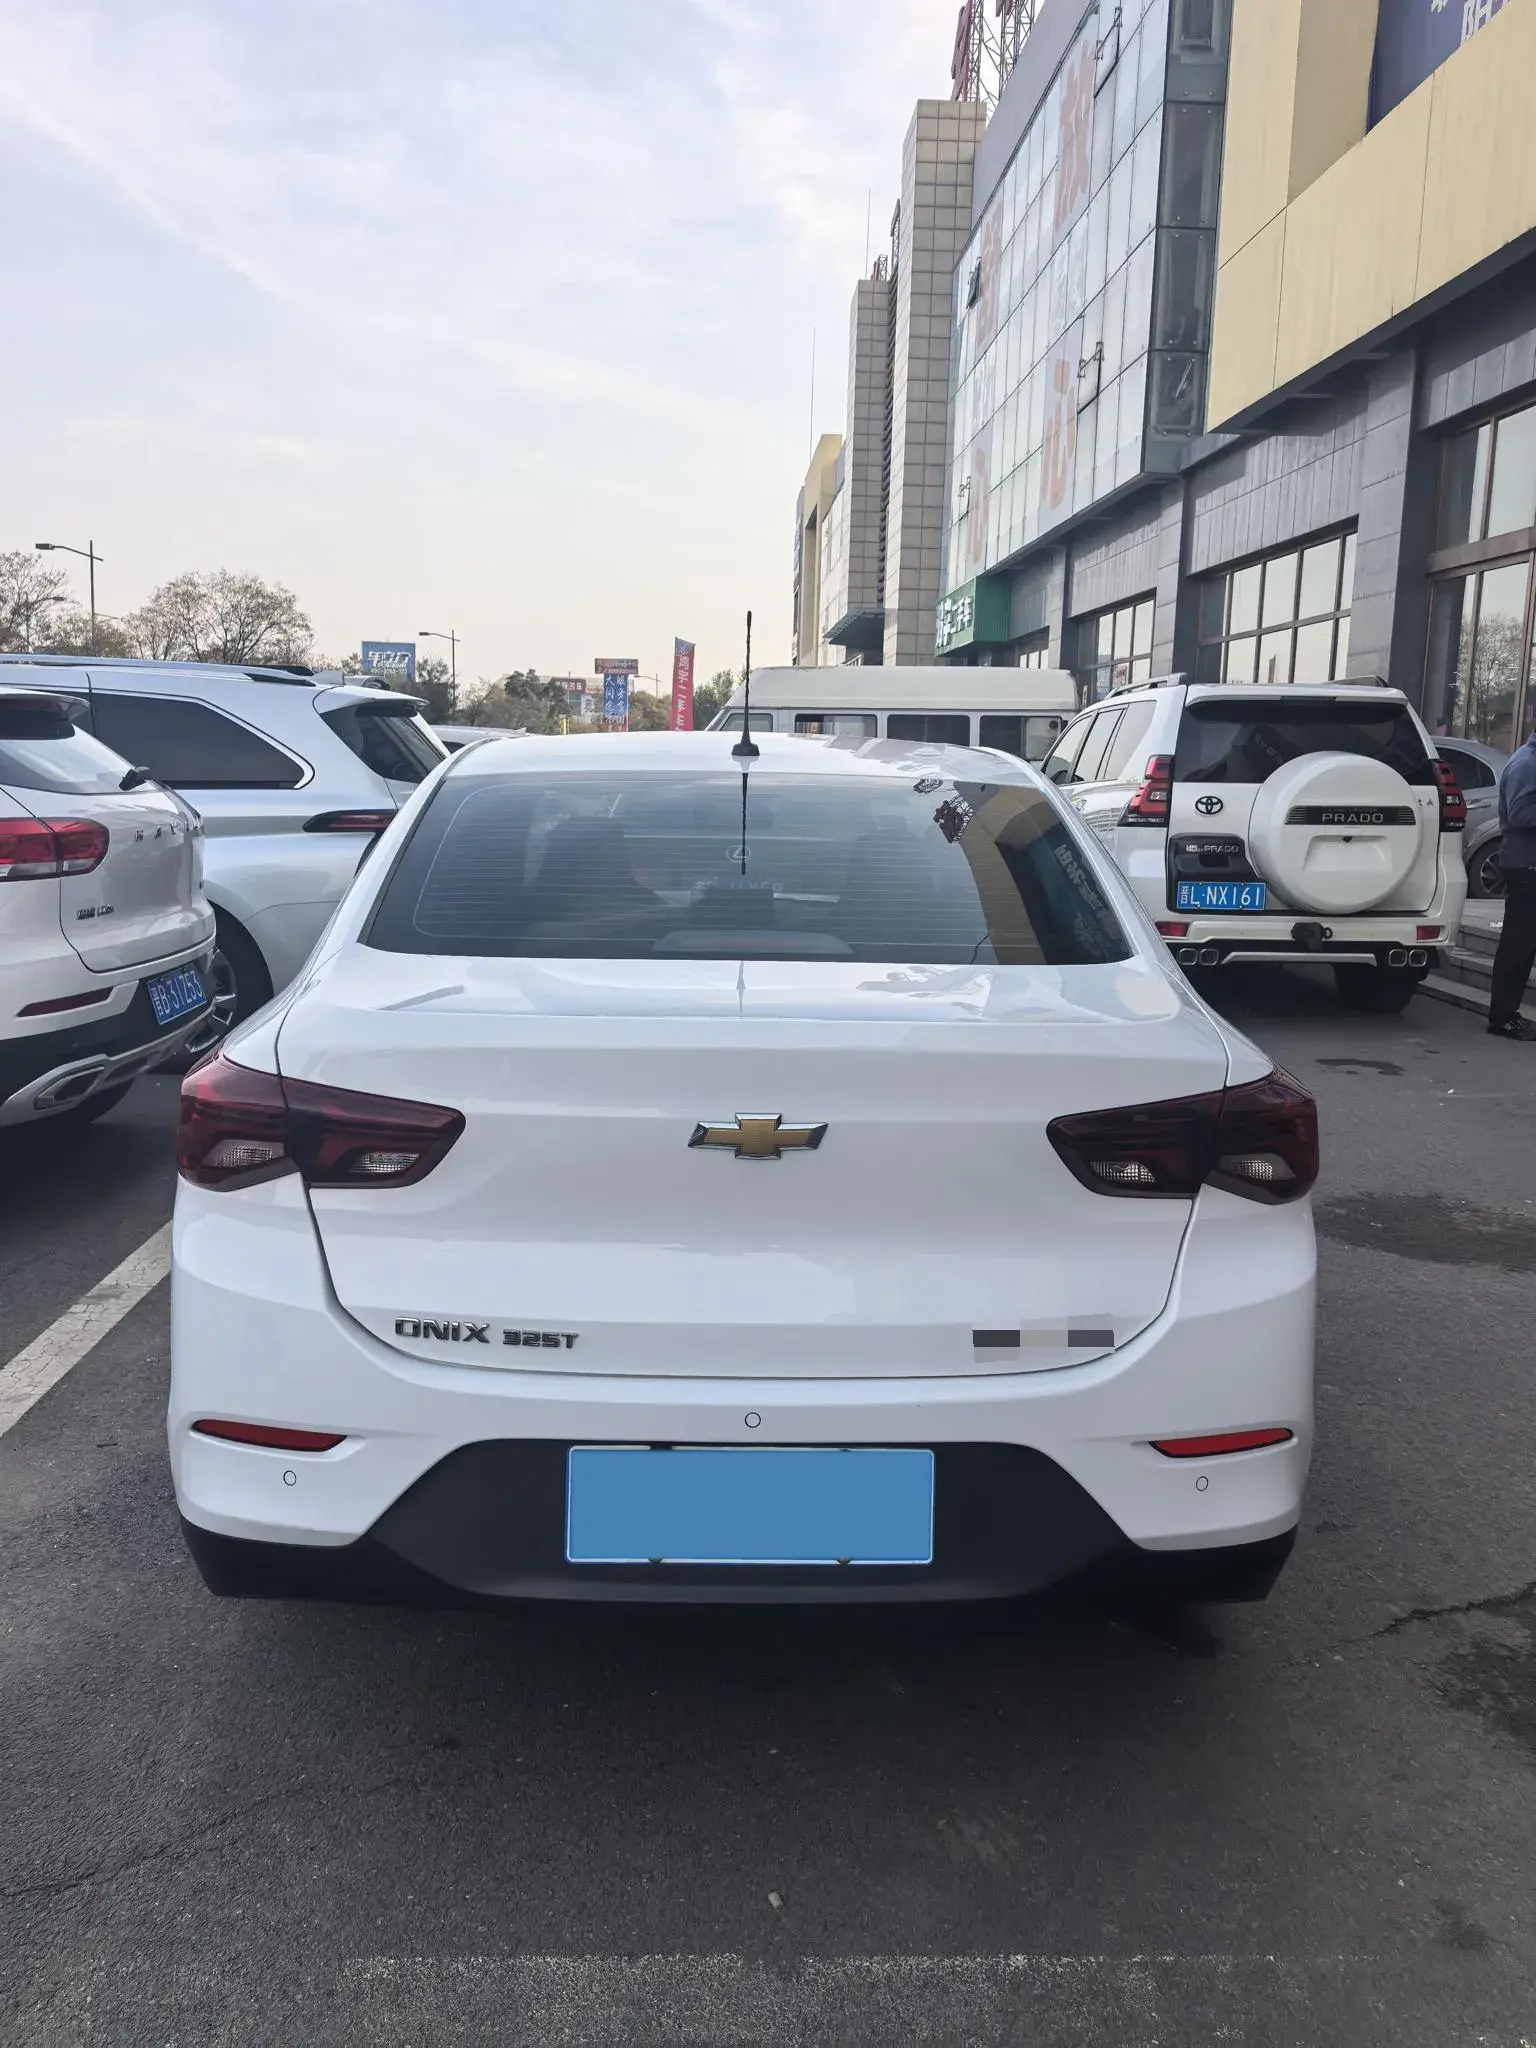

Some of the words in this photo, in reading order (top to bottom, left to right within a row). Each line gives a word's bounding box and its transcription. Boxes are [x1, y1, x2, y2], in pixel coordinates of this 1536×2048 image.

[1322, 813, 1384, 823] PRADO
[1204, 845, 1239, 853] PRADO
[395, 1317, 490, 1344] ONIX
[503, 1329, 579, 1349] 325T
